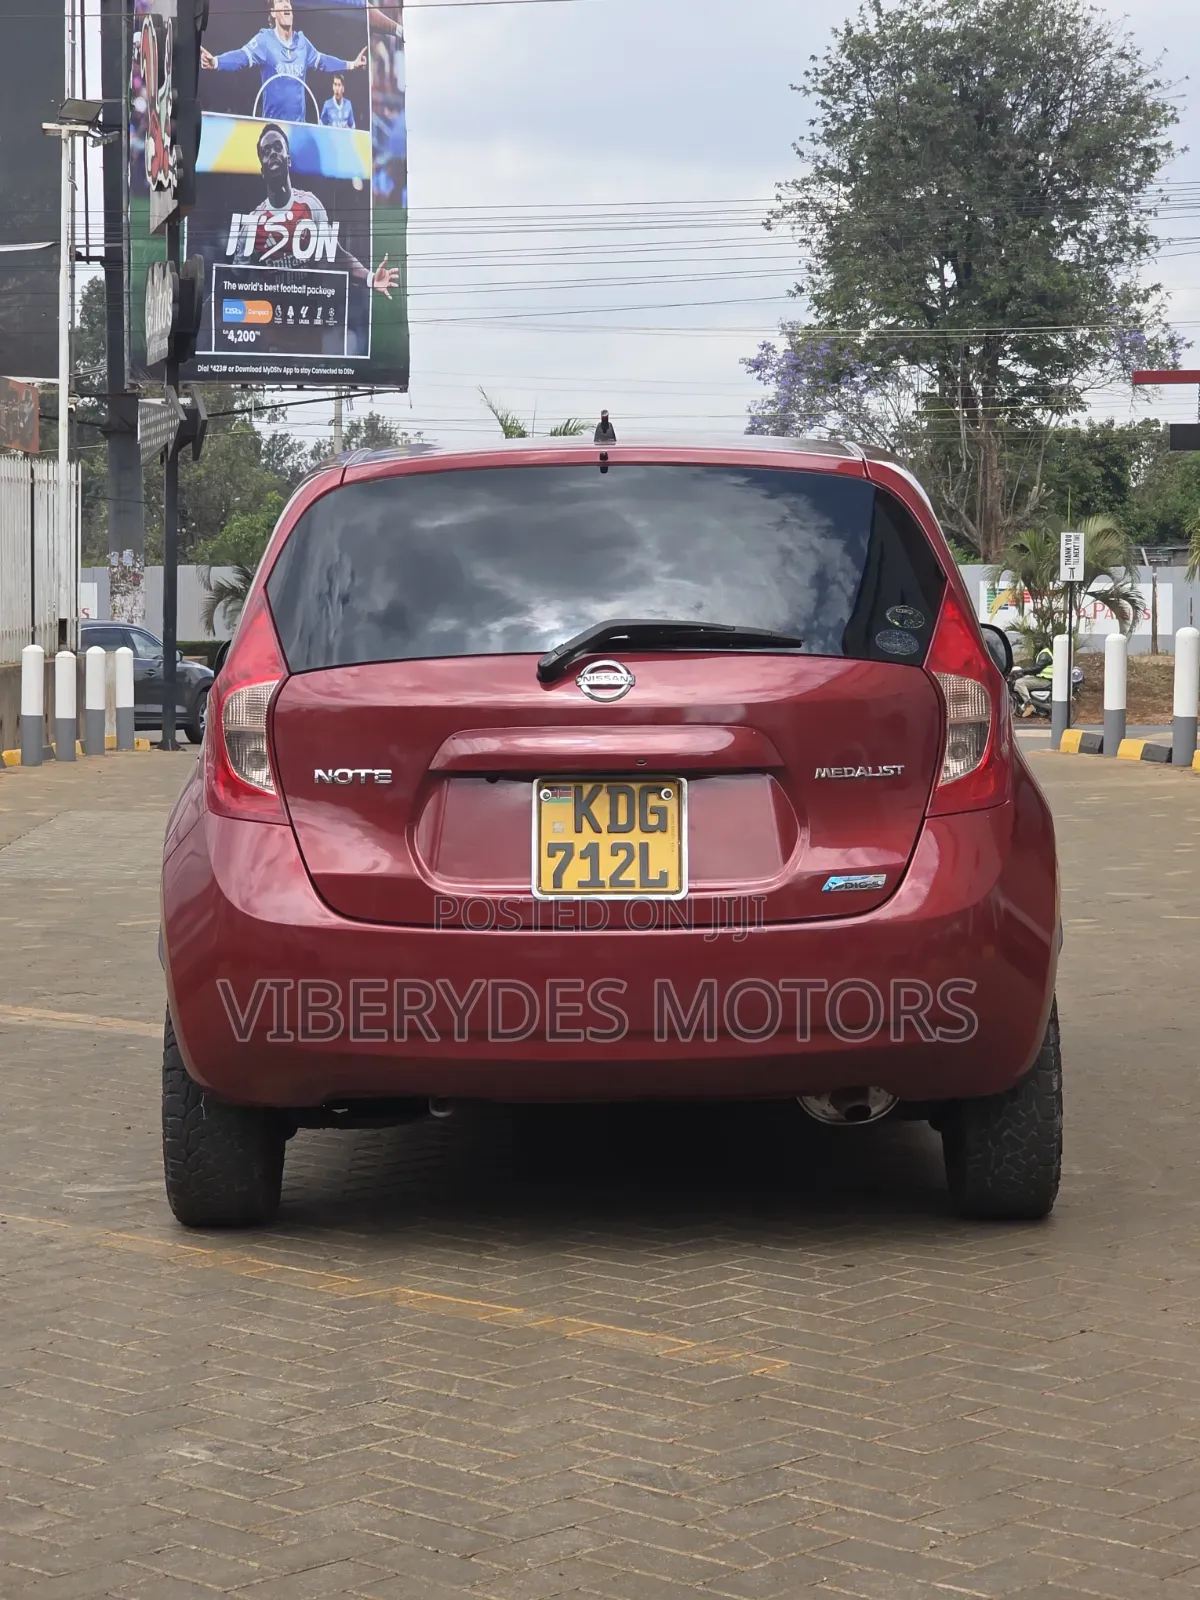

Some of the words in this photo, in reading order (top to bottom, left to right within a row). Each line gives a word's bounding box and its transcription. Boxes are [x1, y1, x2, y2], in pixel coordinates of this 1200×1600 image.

[226, 213, 294, 262] IT'S
[292, 218, 340, 263] ON
[223, 281, 237, 290] The
[238, 281, 263, 292] world's
[264, 282, 280, 292] best
[280, 283, 307, 294] football
[306, 286, 336, 298] package
[224, 307, 244, 315] DStv
[247, 308, 270, 316] Compact
[227, 329, 256, 343] 4,200
[197, 364, 209, 372] Dial
[235, 365, 262, 373] Download
[263, 366, 283, 375] MyDStv
[283, 367, 294, 375] App
[300, 367, 311, 376] stay
[311, 367, 338, 375] Connected
[1064, 534, 1072, 546] YOU
[1064, 546, 1072, 566] THANK
[1072, 545, 1080, 558] NEXT
[582, 674, 629, 683] NISSAN
[313, 768, 393, 784] NOTE
[814, 764, 905, 779] MEDALIST
[573, 784, 669, 834] KDG
[546, 841, 669, 889] 712L
